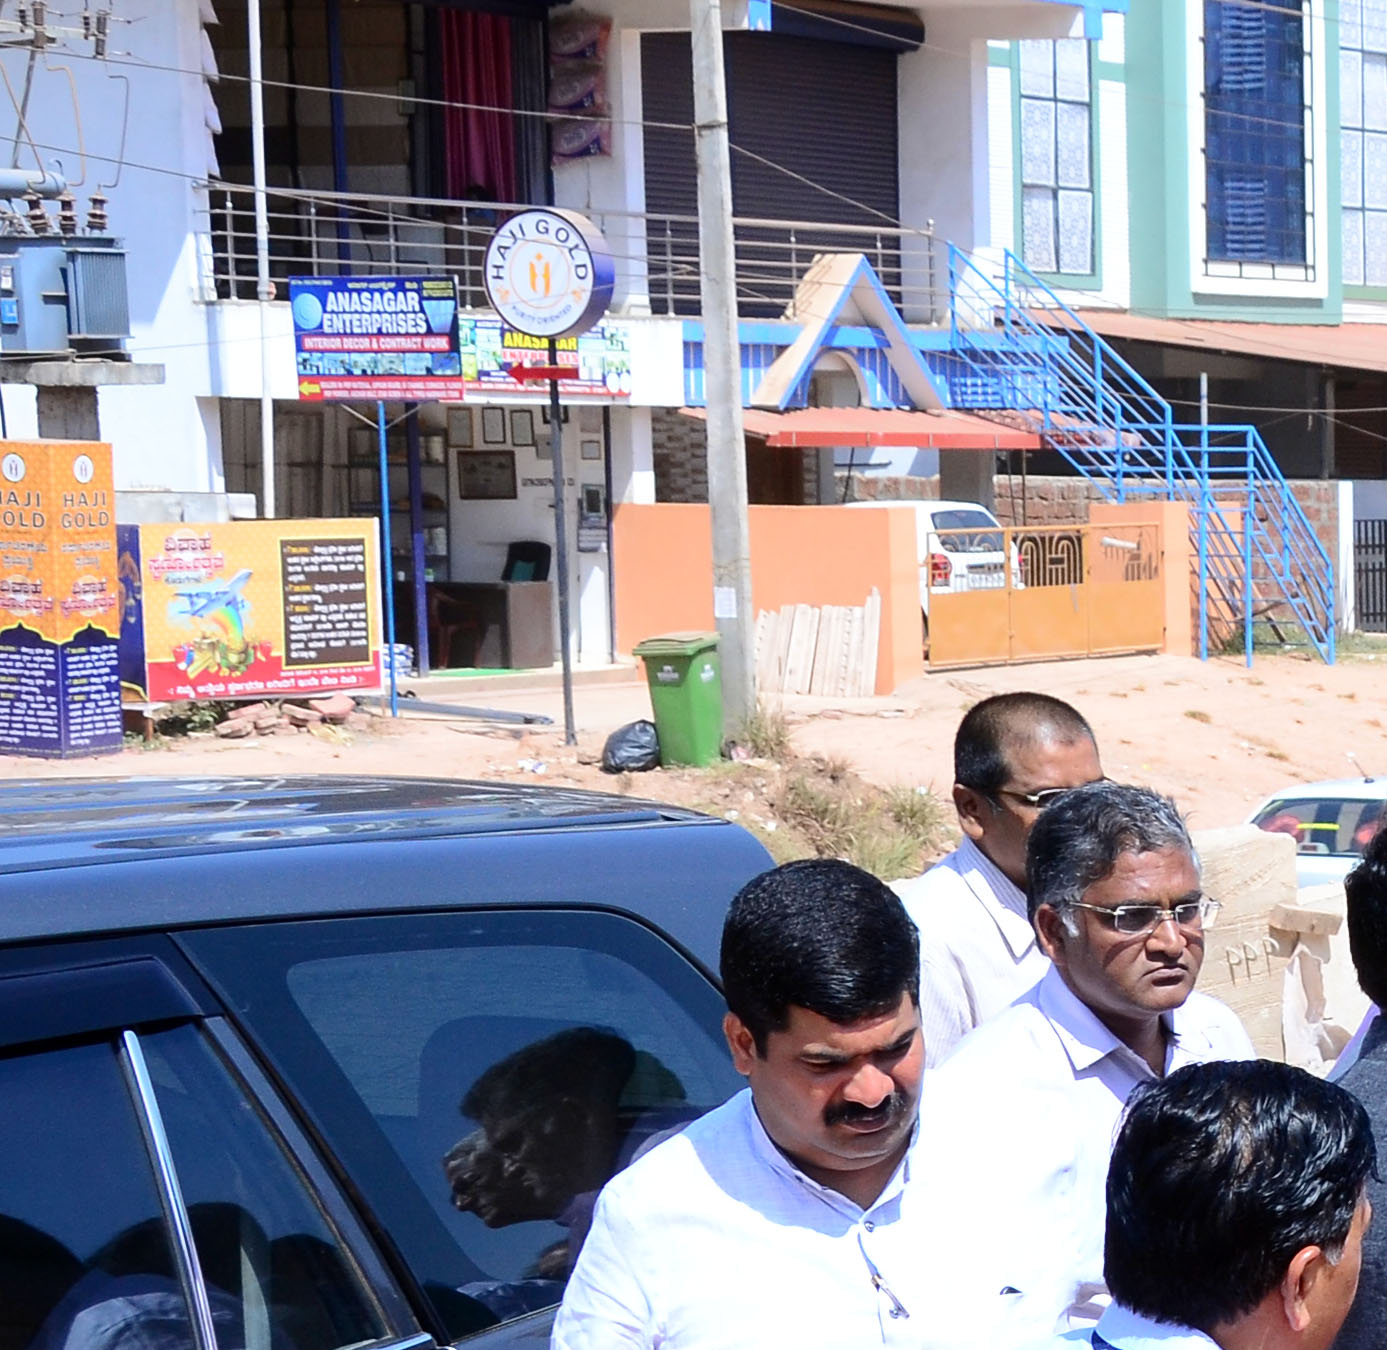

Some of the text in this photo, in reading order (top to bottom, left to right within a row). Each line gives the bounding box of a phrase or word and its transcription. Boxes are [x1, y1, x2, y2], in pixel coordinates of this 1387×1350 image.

[491, 219, 588, 280] HAJI GOLD
[326, 291, 420, 312] ANASAGAR
[323, 313, 427, 335] ENTERPRISES
[304, 337, 450, 350] INTERIOR DECOR & CONTRACT WORK
[504, 332, 577, 349] ANASAAR
[0, 490, 41, 508] AJI
[63, 492, 107, 508] HAJI
[0, 511, 46, 529] OLD
[61, 511, 110, 529] GOLD
